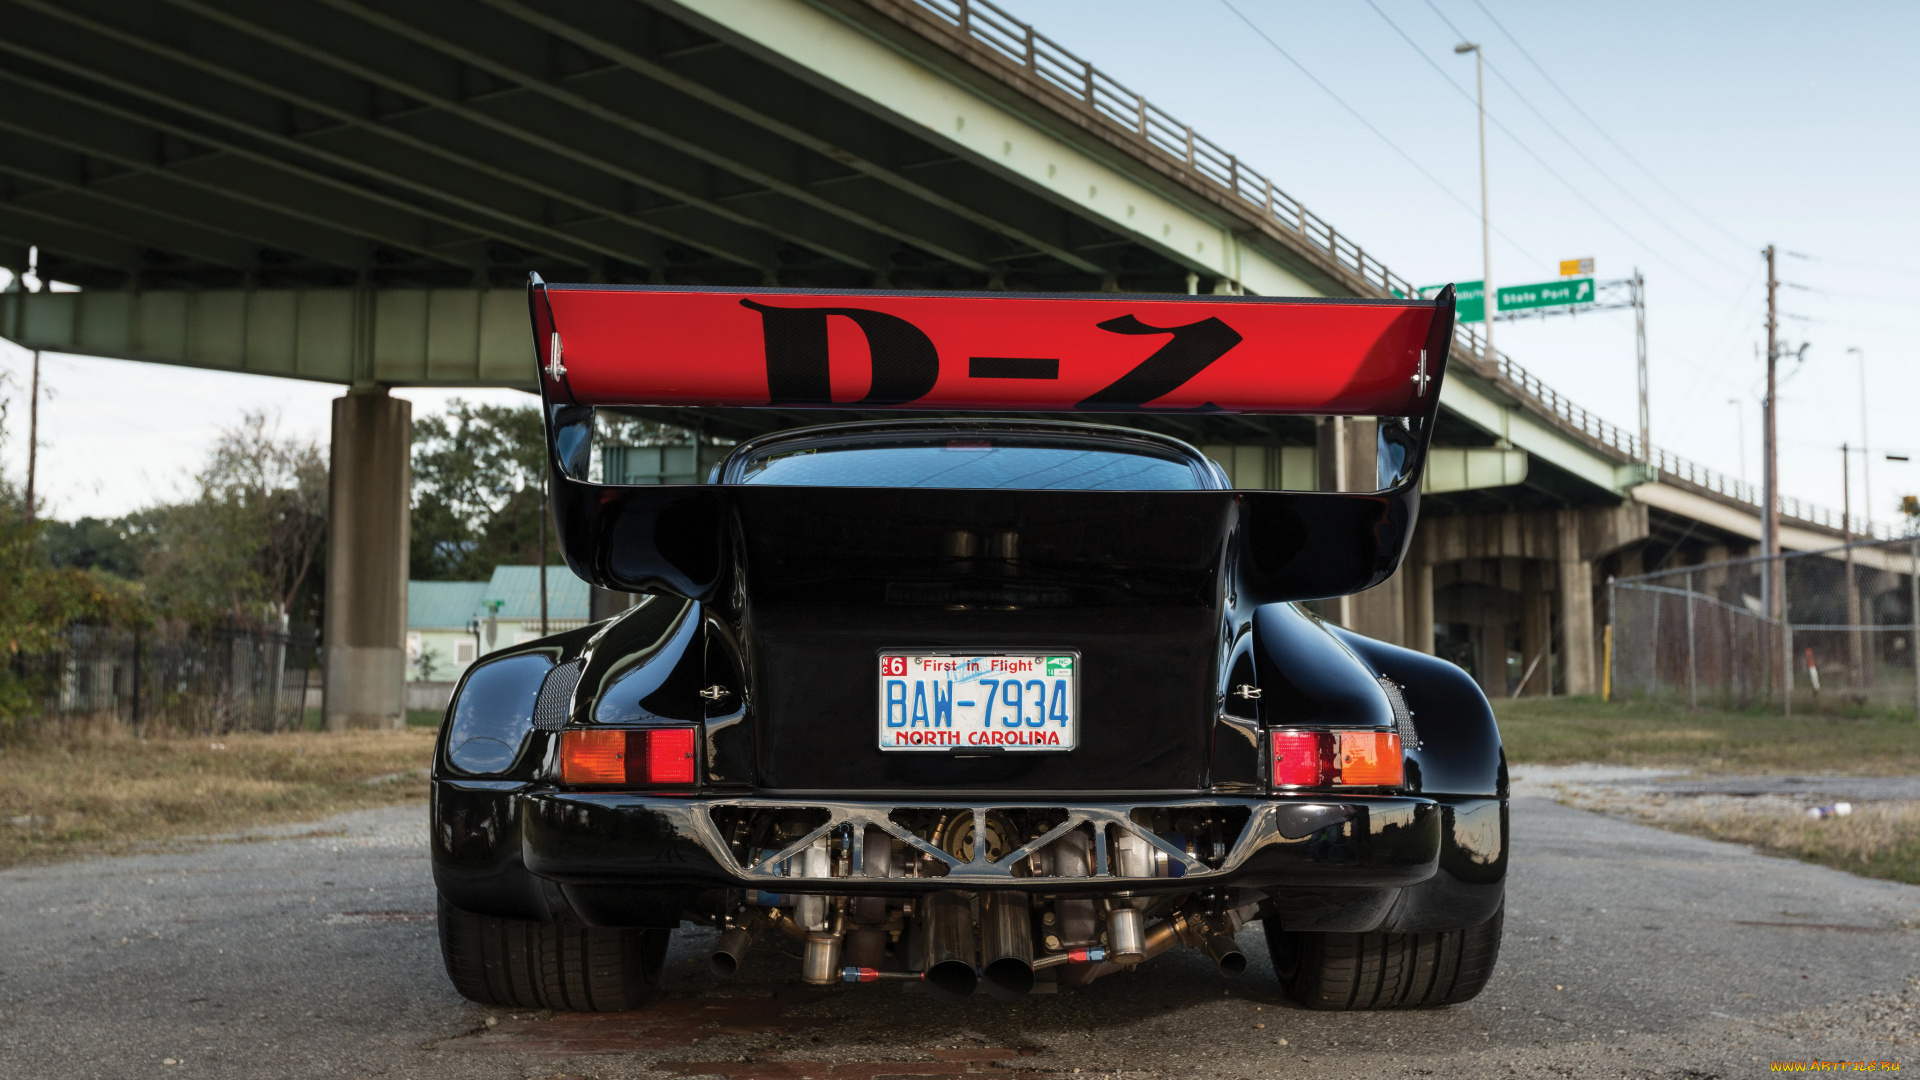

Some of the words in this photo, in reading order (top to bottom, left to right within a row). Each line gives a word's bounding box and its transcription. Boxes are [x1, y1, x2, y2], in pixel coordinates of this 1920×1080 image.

[1502, 292, 1537, 305] State
[1541, 288, 1570, 300] Port
[891, 657, 903, 675] 6
[923, 659, 957, 672] First
[967, 659, 980, 672] in
[991, 659, 1033, 674] Flight
[887, 679, 1069, 728] BAW-7934
[896, 731, 960, 745] NORTH
[968, 731, 1060, 745] CAROLINA
